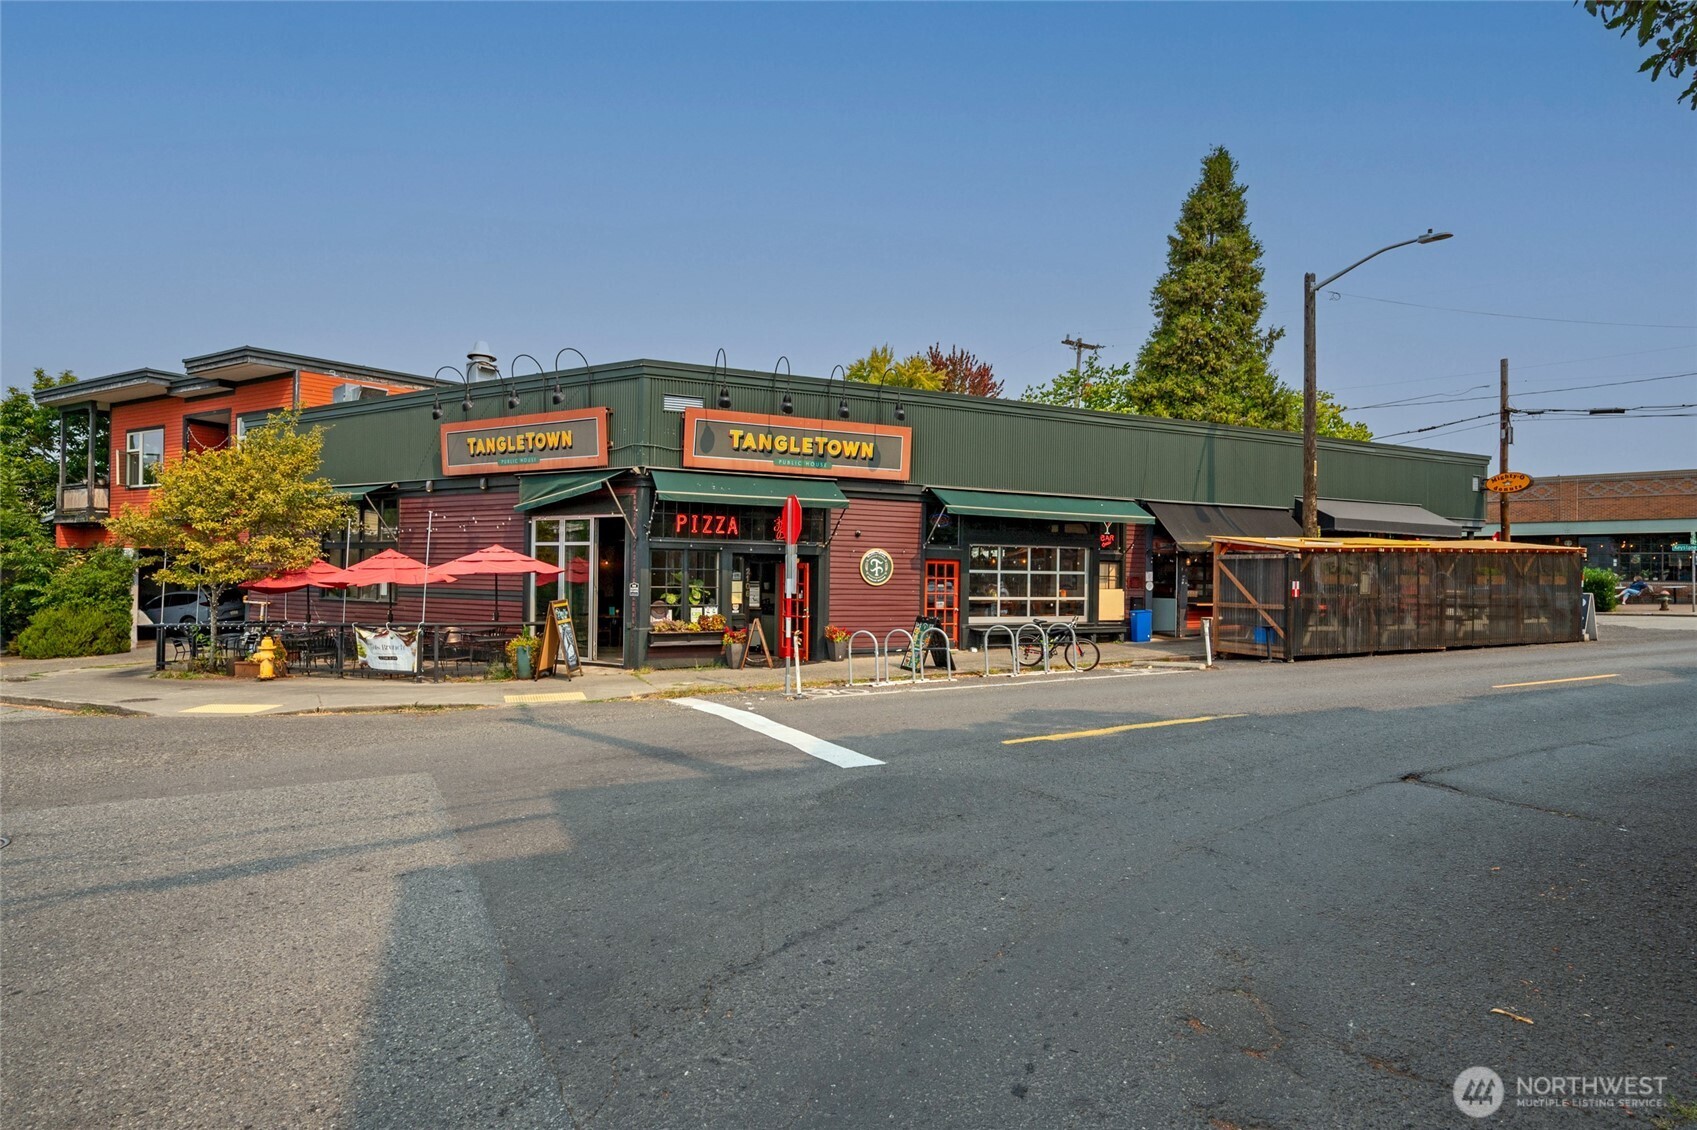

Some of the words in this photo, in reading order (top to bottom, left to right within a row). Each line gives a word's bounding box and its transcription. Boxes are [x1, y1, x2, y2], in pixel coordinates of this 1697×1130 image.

[467, 430, 573, 456] TANGLETOWN
[729, 429, 874, 460] TANGLETOWN
[676, 513, 739, 535] PIZZA
